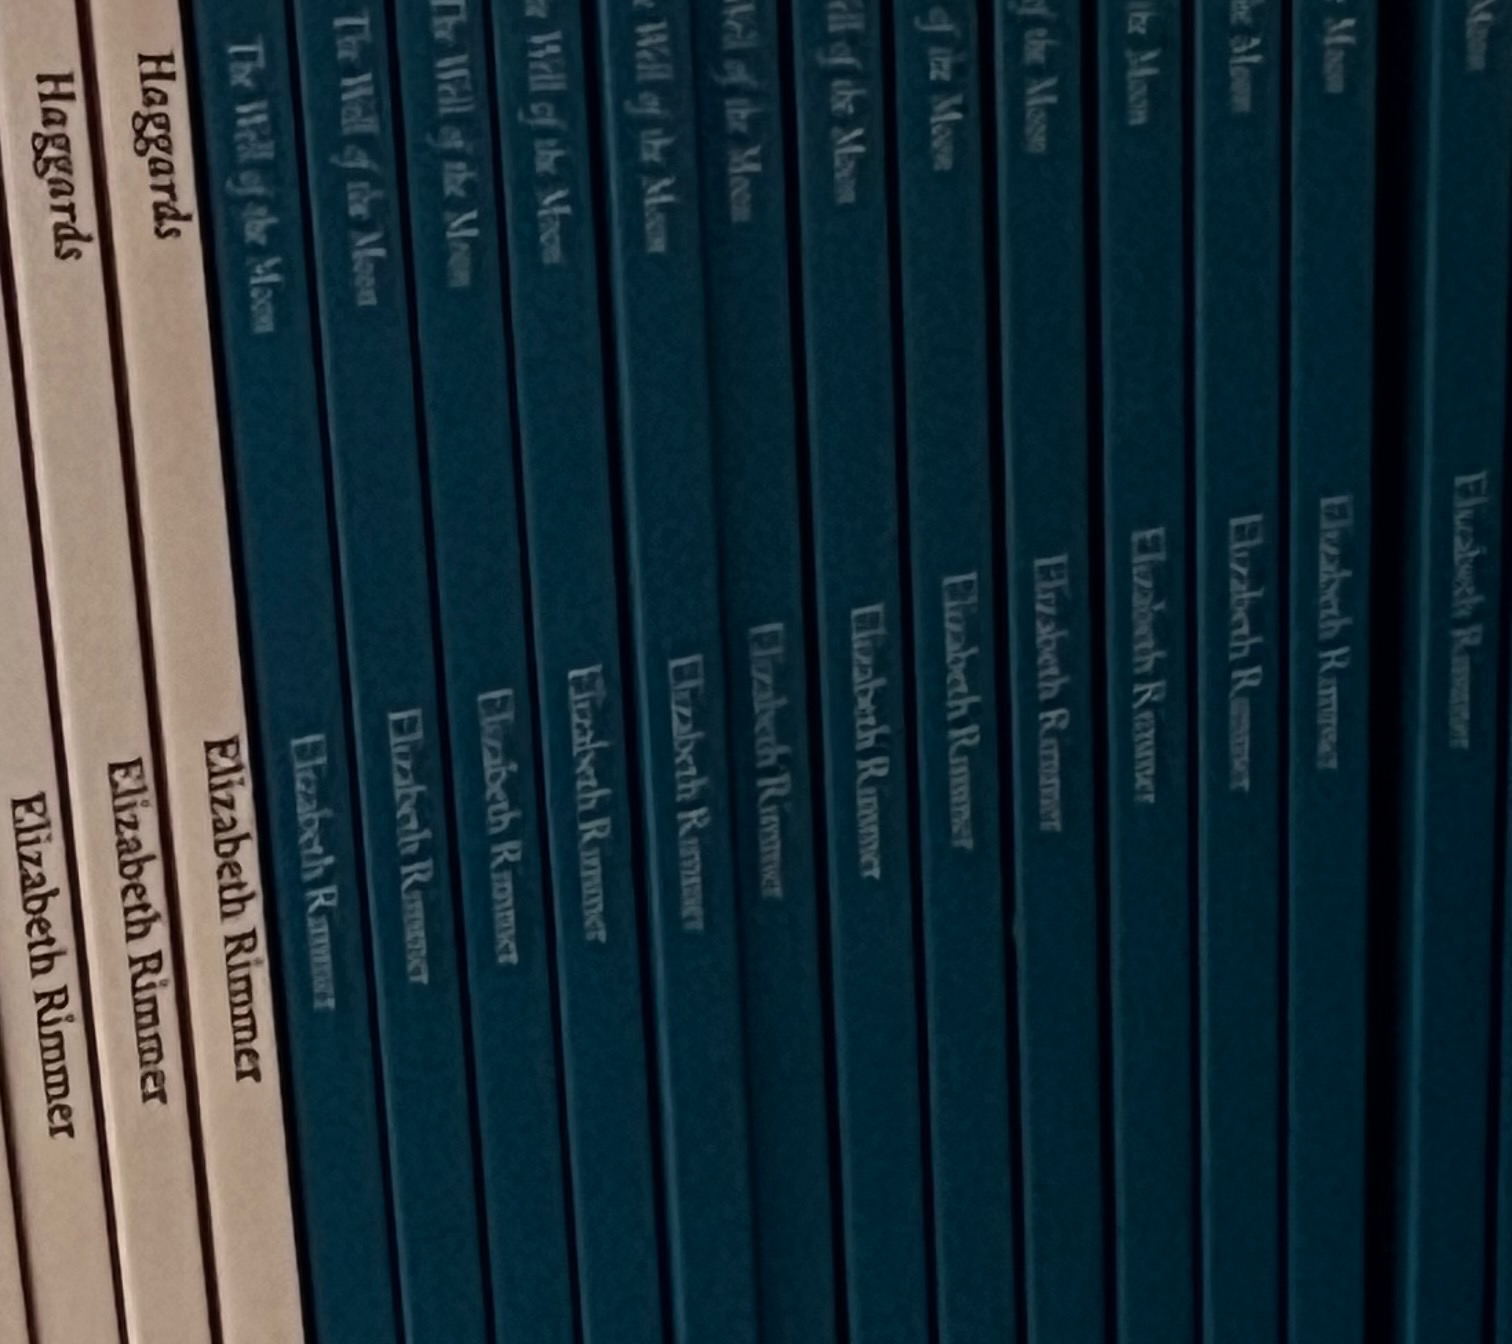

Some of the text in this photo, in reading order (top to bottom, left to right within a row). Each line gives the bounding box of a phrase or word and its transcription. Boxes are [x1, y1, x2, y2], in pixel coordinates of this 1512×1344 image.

[30, 71, 95, 261] Haggards
[130, 49, 194, 240] Haggards
[10, 790, 77, 1140] Elizabeth Rimmer
[107, 756, 170, 1106] Elizabeth Rimmer
[203, 733, 264, 1084] Elizabeth Rimmer
